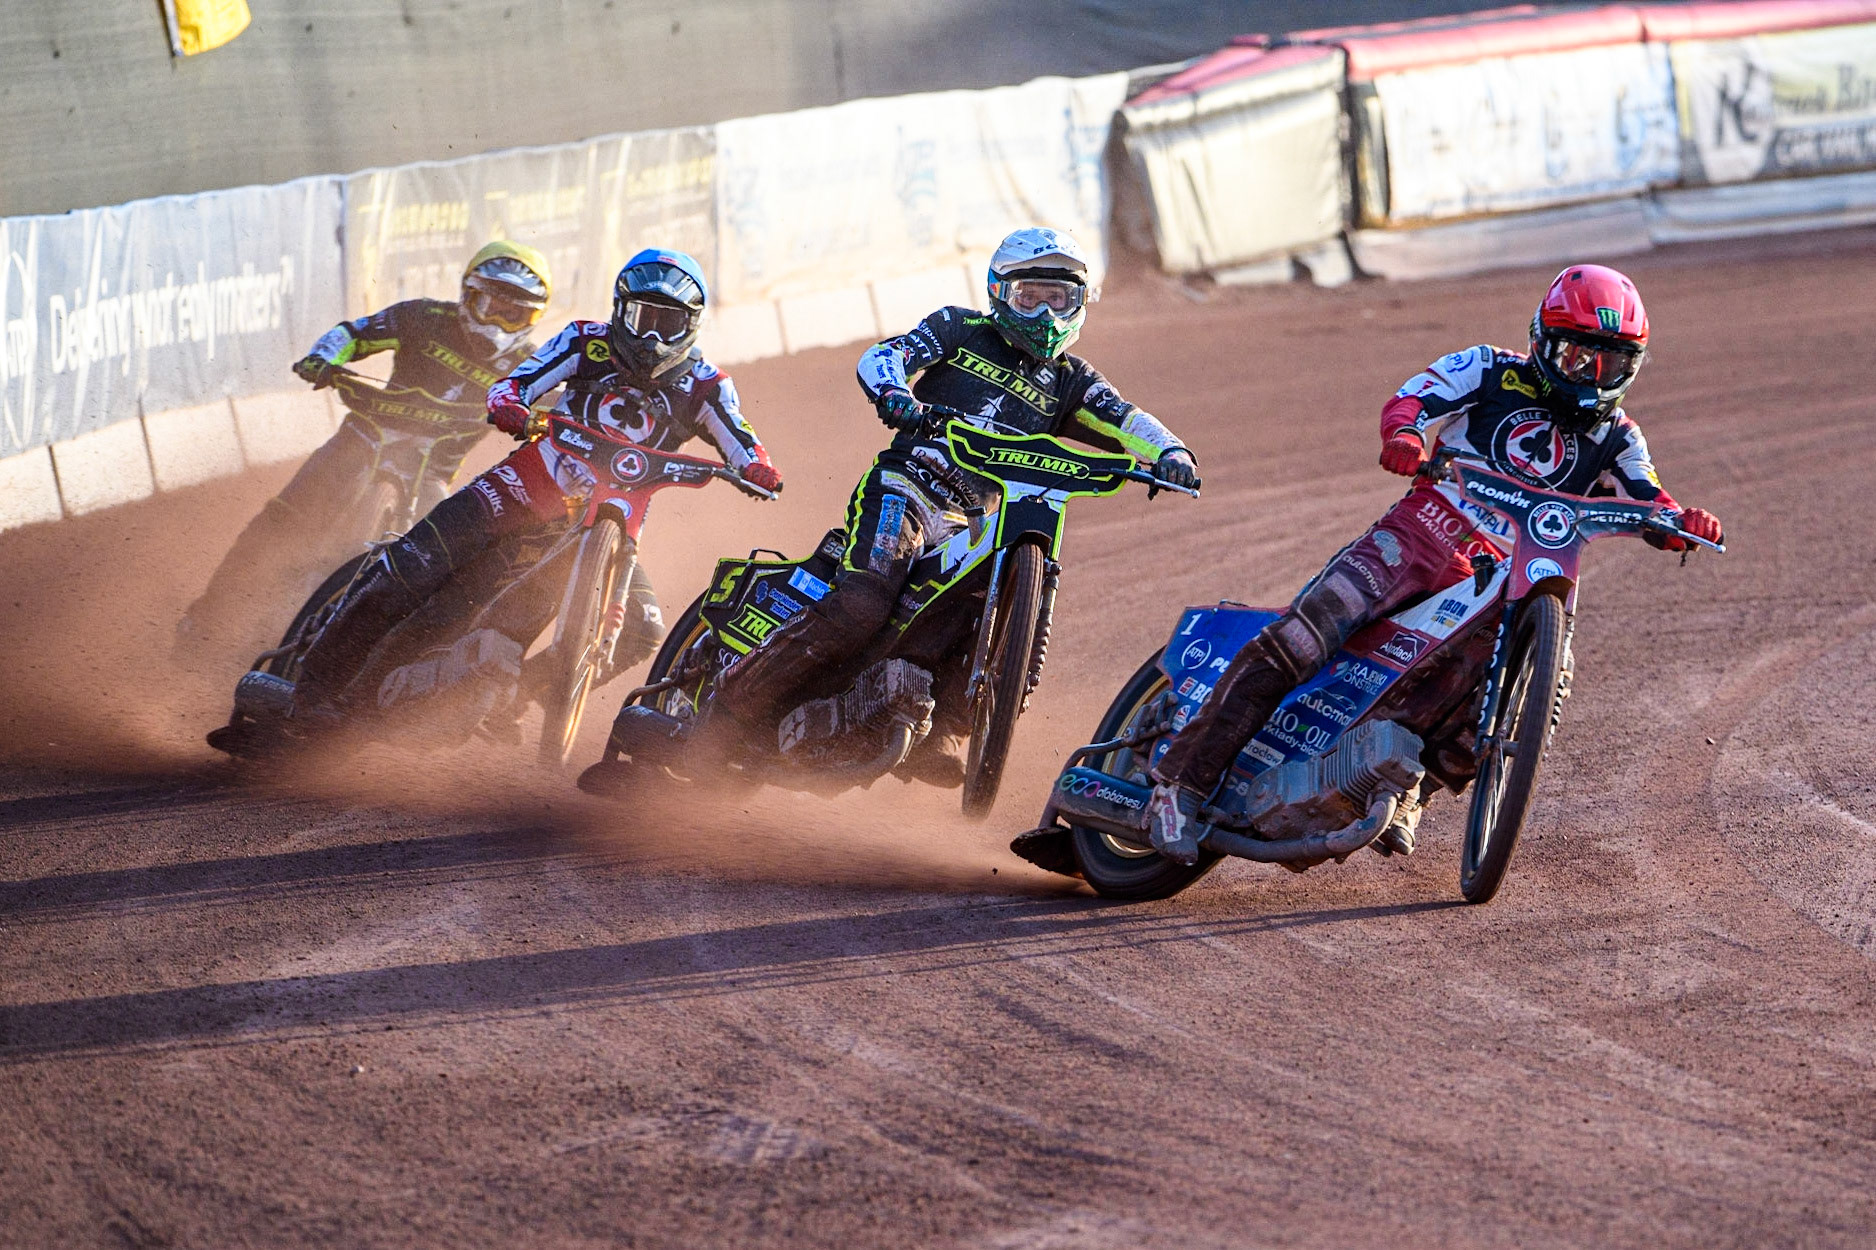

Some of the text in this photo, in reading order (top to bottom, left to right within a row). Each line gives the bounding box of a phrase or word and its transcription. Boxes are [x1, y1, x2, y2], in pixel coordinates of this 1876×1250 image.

[962, 354, 1055, 412] TRU MIX
[1509, 411, 1542, 426] BELLE
[997, 451, 1083, 475] TRU MIX
[1418, 500, 1463, 537] BIO
[1180, 613, 1202, 636] 1
